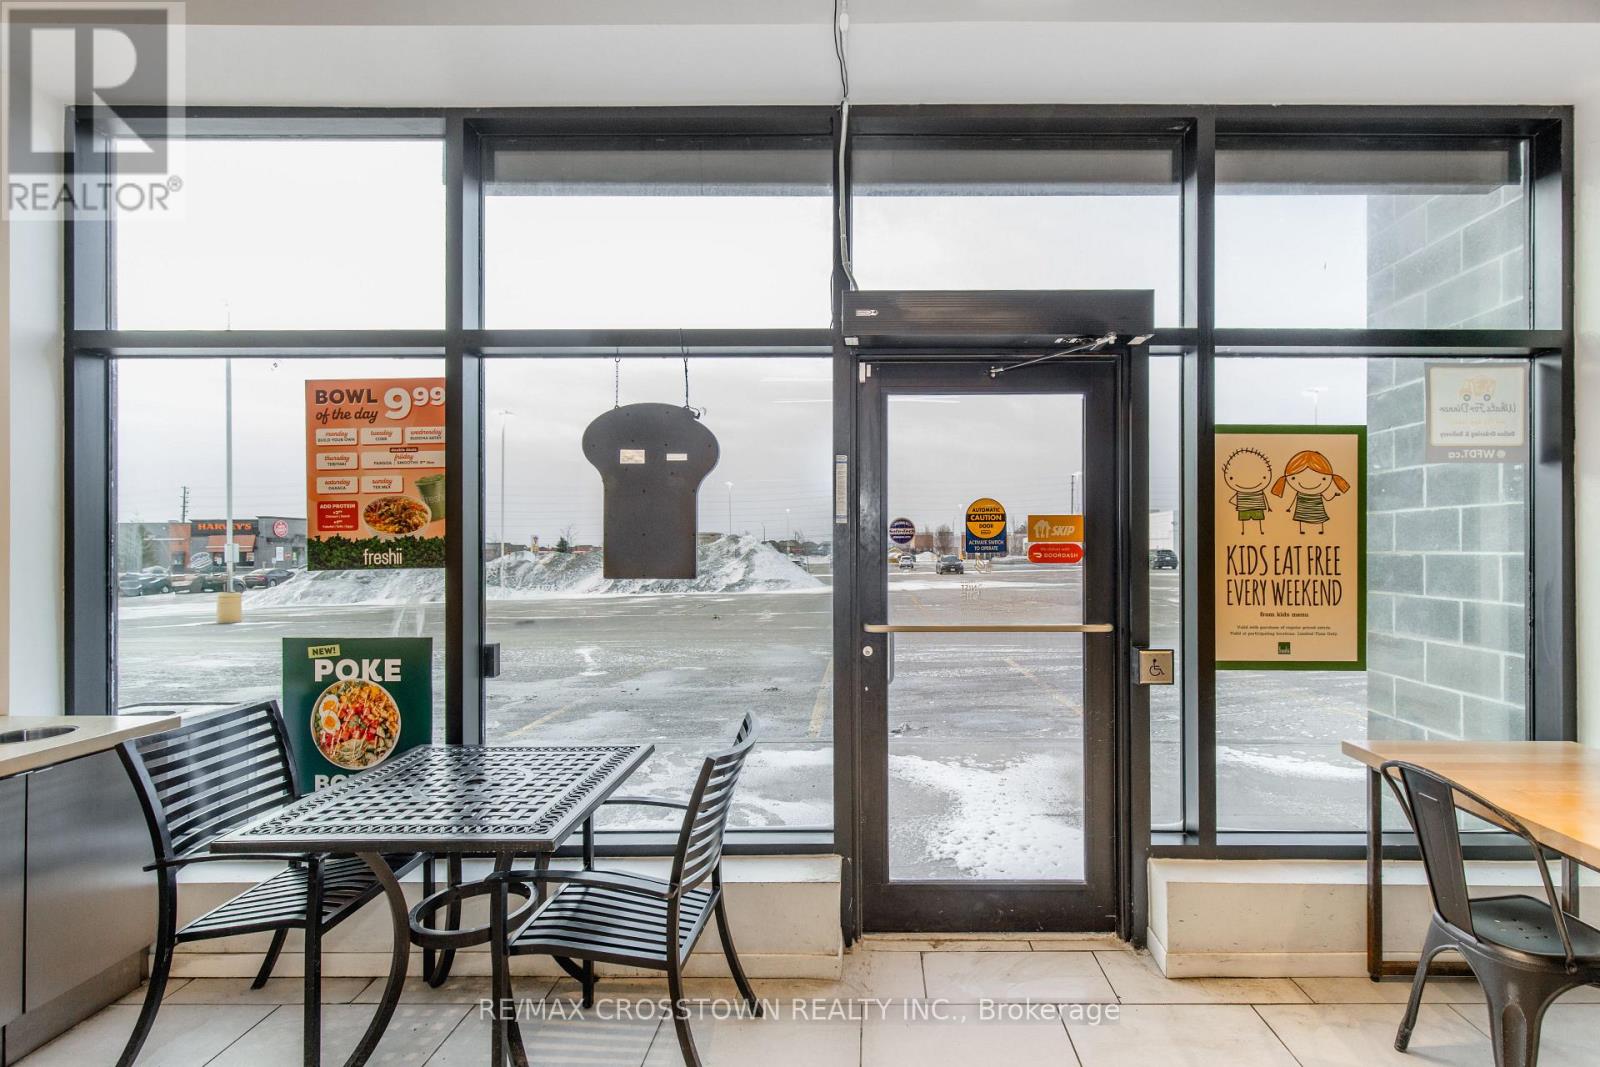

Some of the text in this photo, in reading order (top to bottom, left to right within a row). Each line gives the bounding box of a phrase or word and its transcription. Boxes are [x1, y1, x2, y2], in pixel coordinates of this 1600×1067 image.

[316, 389, 378, 404] BOWL
[316, 407, 378, 424] of the day
[325, 430, 349, 438] monday
[410, 428, 443, 437] wednesday
[324, 454, 351, 463] thursday
[393, 453, 415, 463] friday
[324, 479, 351, 487] saturday
[372, 478, 393, 486] sunday
[970, 513, 1002, 521] CAUTION
[1050, 525, 1076, 536] SKIP
[363, 547, 403, 565] freshii
[1226, 545, 1342, 576] KIDS EAT FREE
[1226, 579, 1342, 606] EVERY WEEKEND
[312, 647, 336, 656] NEW!
[314, 658, 402, 682] POKE
